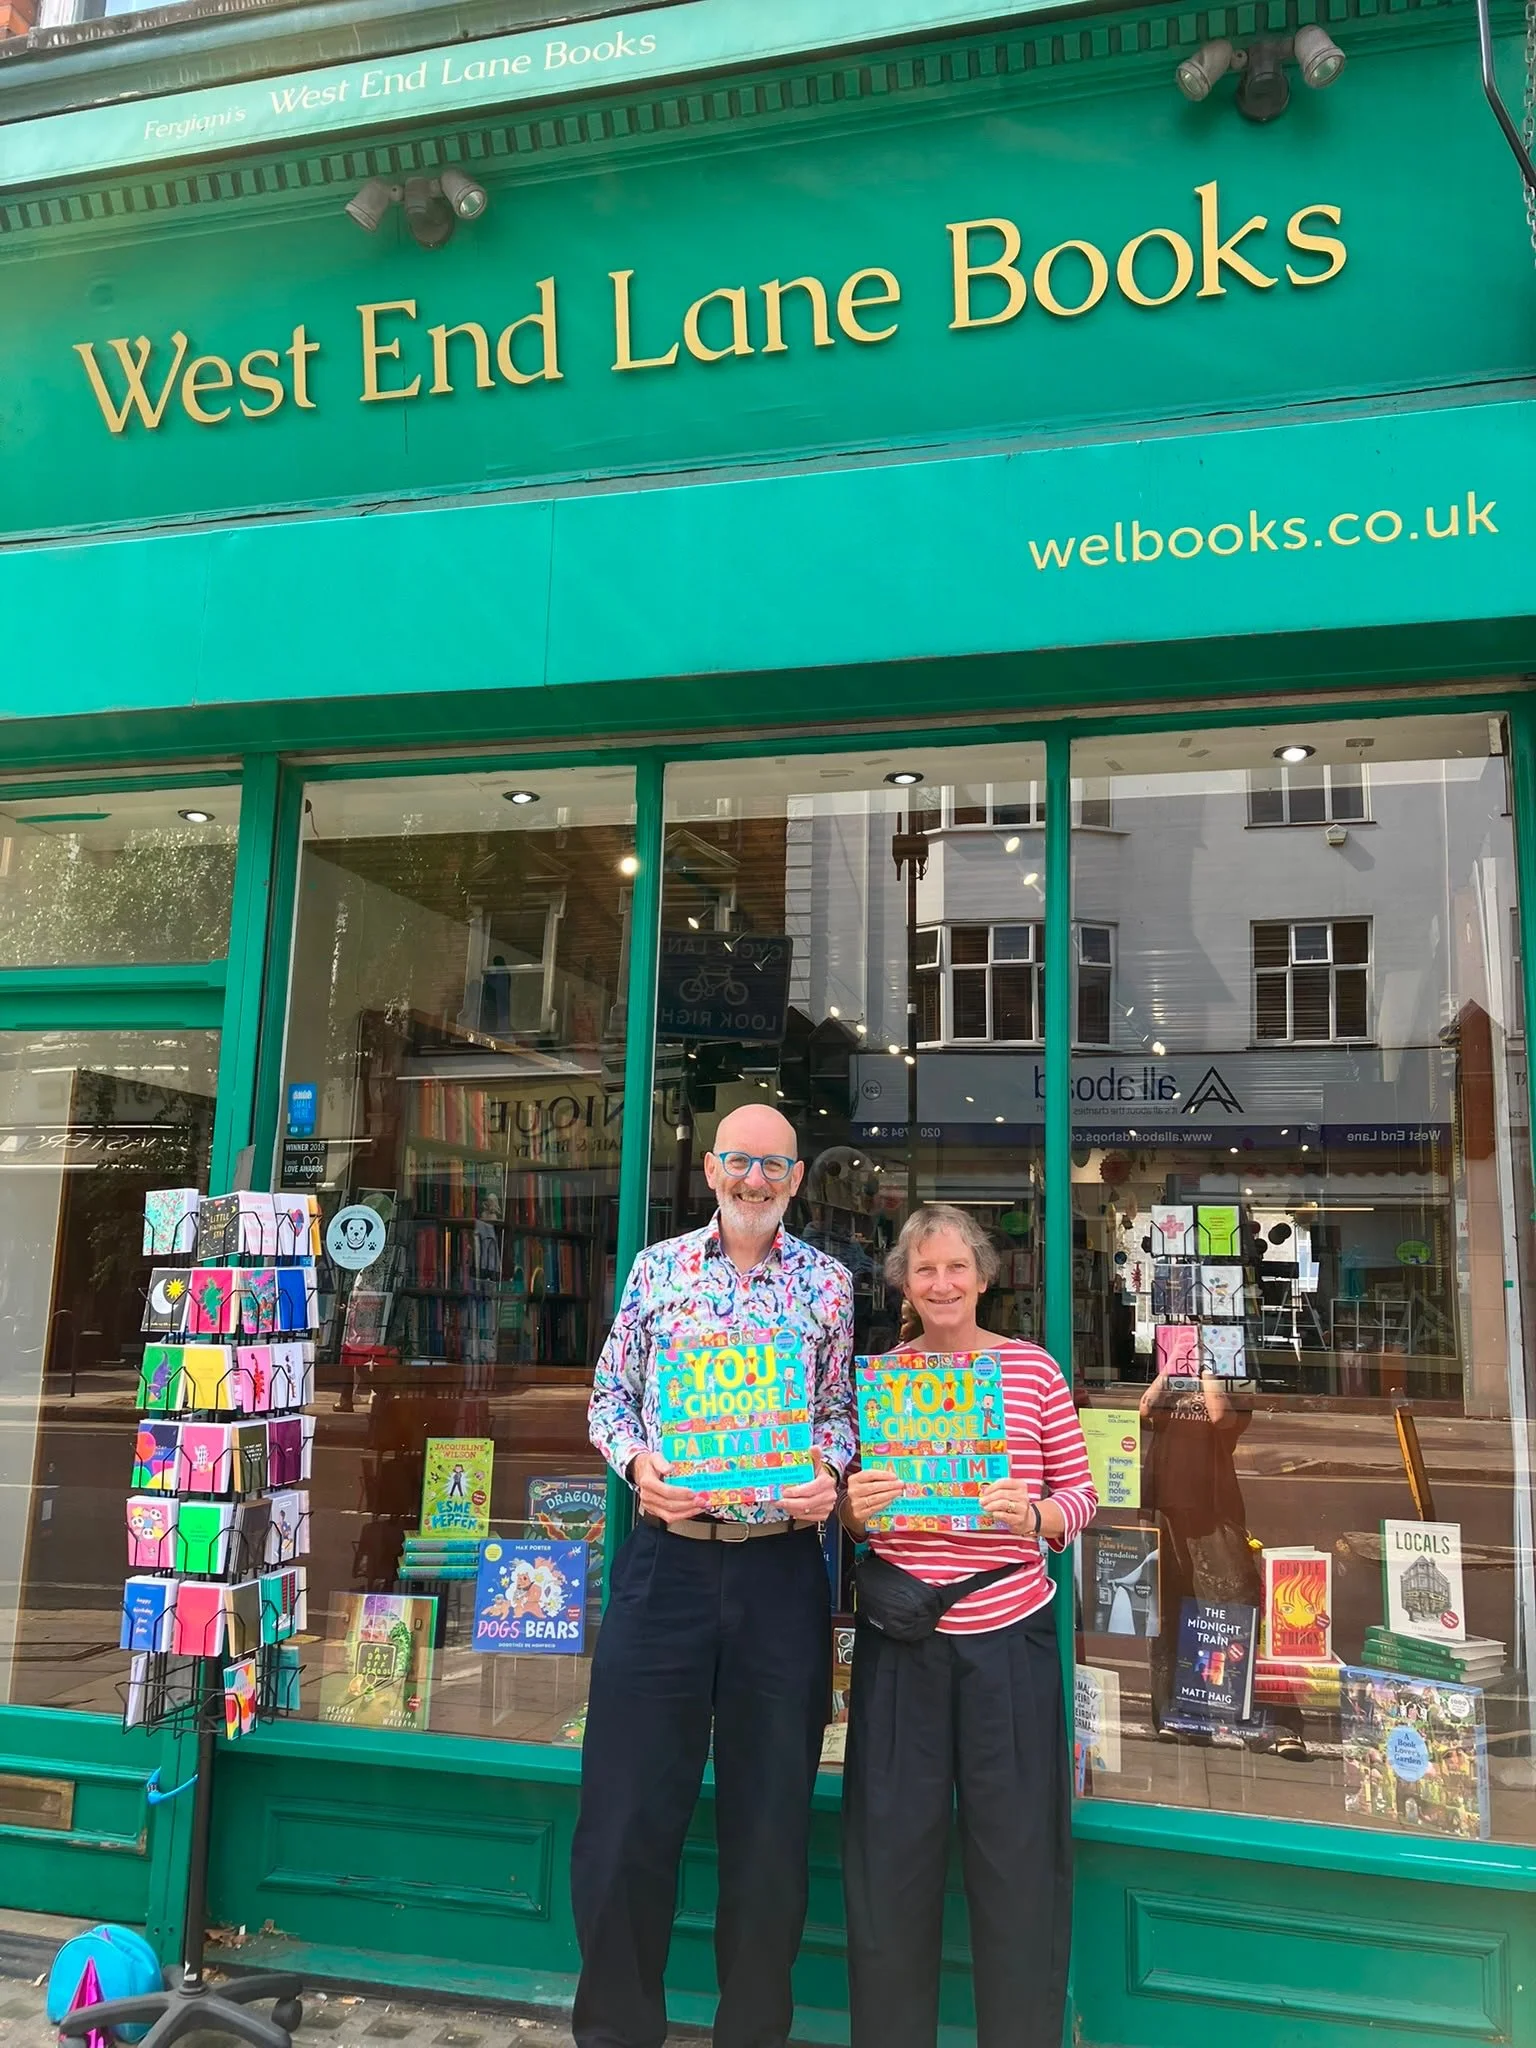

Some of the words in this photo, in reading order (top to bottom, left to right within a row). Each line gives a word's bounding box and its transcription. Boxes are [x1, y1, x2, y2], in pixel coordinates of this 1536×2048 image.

[143, 105, 248, 140] Fergiani's
[268, 81, 349, 116] West
[360, 65, 428, 100] End
[441, 54, 532, 88] Lane
[543, 29, 658, 70] Books
[72, 324, 321, 433] West
[356, 275, 564, 403] End
[608, 269, 902, 372] Lane
[945, 180, 1348, 332] Books
[1028, 491, 1499, 570] welbooks.co.uk
[285, 1143, 309, 1152] WINNER
[310, 1143, 325, 1152] 2018
[284, 1165, 299, 1173] LOVE
[299, 1165, 324, 1173] AWARDS
[684, 1344, 777, 1391] YOU
[881, 1370, 976, 1415] YOU
[684, 1386, 782, 1418] CHOOSE
[882, 1415, 979, 1440] CHOOSE
[435, 1443, 485, 1451] JACQUELINE
[673, 1432, 743, 1458] PARTY
[750, 1426, 805, 1451] TIME
[443, 1451, 477, 1459] WILSON
[1109, 1457, 1133, 1466] things
[947, 1457, 1002, 1479] TIME
[1108, 1472, 1124, 1480] told
[1108, 1480, 1121, 1488] my
[1108, 1487, 1131, 1495] notes
[545, 1490, 607, 1511] DRAGONS
[1108, 1496, 1124, 1504] app
[436, 1500, 472, 1514] ESME
[1099, 1533, 1113, 1541] The
[1098, 1541, 1116, 1549] Palm
[1116, 1543, 1138, 1551] House
[1396, 1531, 1451, 1555] LOCALS
[1098, 1550, 1138, 1560] Gwendoline
[1098, 1557, 1117, 1567] Riley
[1204, 1607, 1227, 1620] THE
[476, 1619, 521, 1639] DOGS
[525, 1620, 580, 1640] BEARS
[1280, 1631, 1320, 1646] THINGS
[367, 1652, 389, 1660] DAY
[366, 1660, 386, 1668] OFF
[361, 1667, 392, 1675] SCHOOL
[1181, 1687, 1207, 1700] MATT
[1208, 1692, 1233, 1705] HAIG
[1403, 1732, 1410, 1741] A
[1397, 1739, 1417, 1749] Book
[1394, 1745, 1421, 1759] Lover's
[1394, 1754, 1422, 1766] Garden
